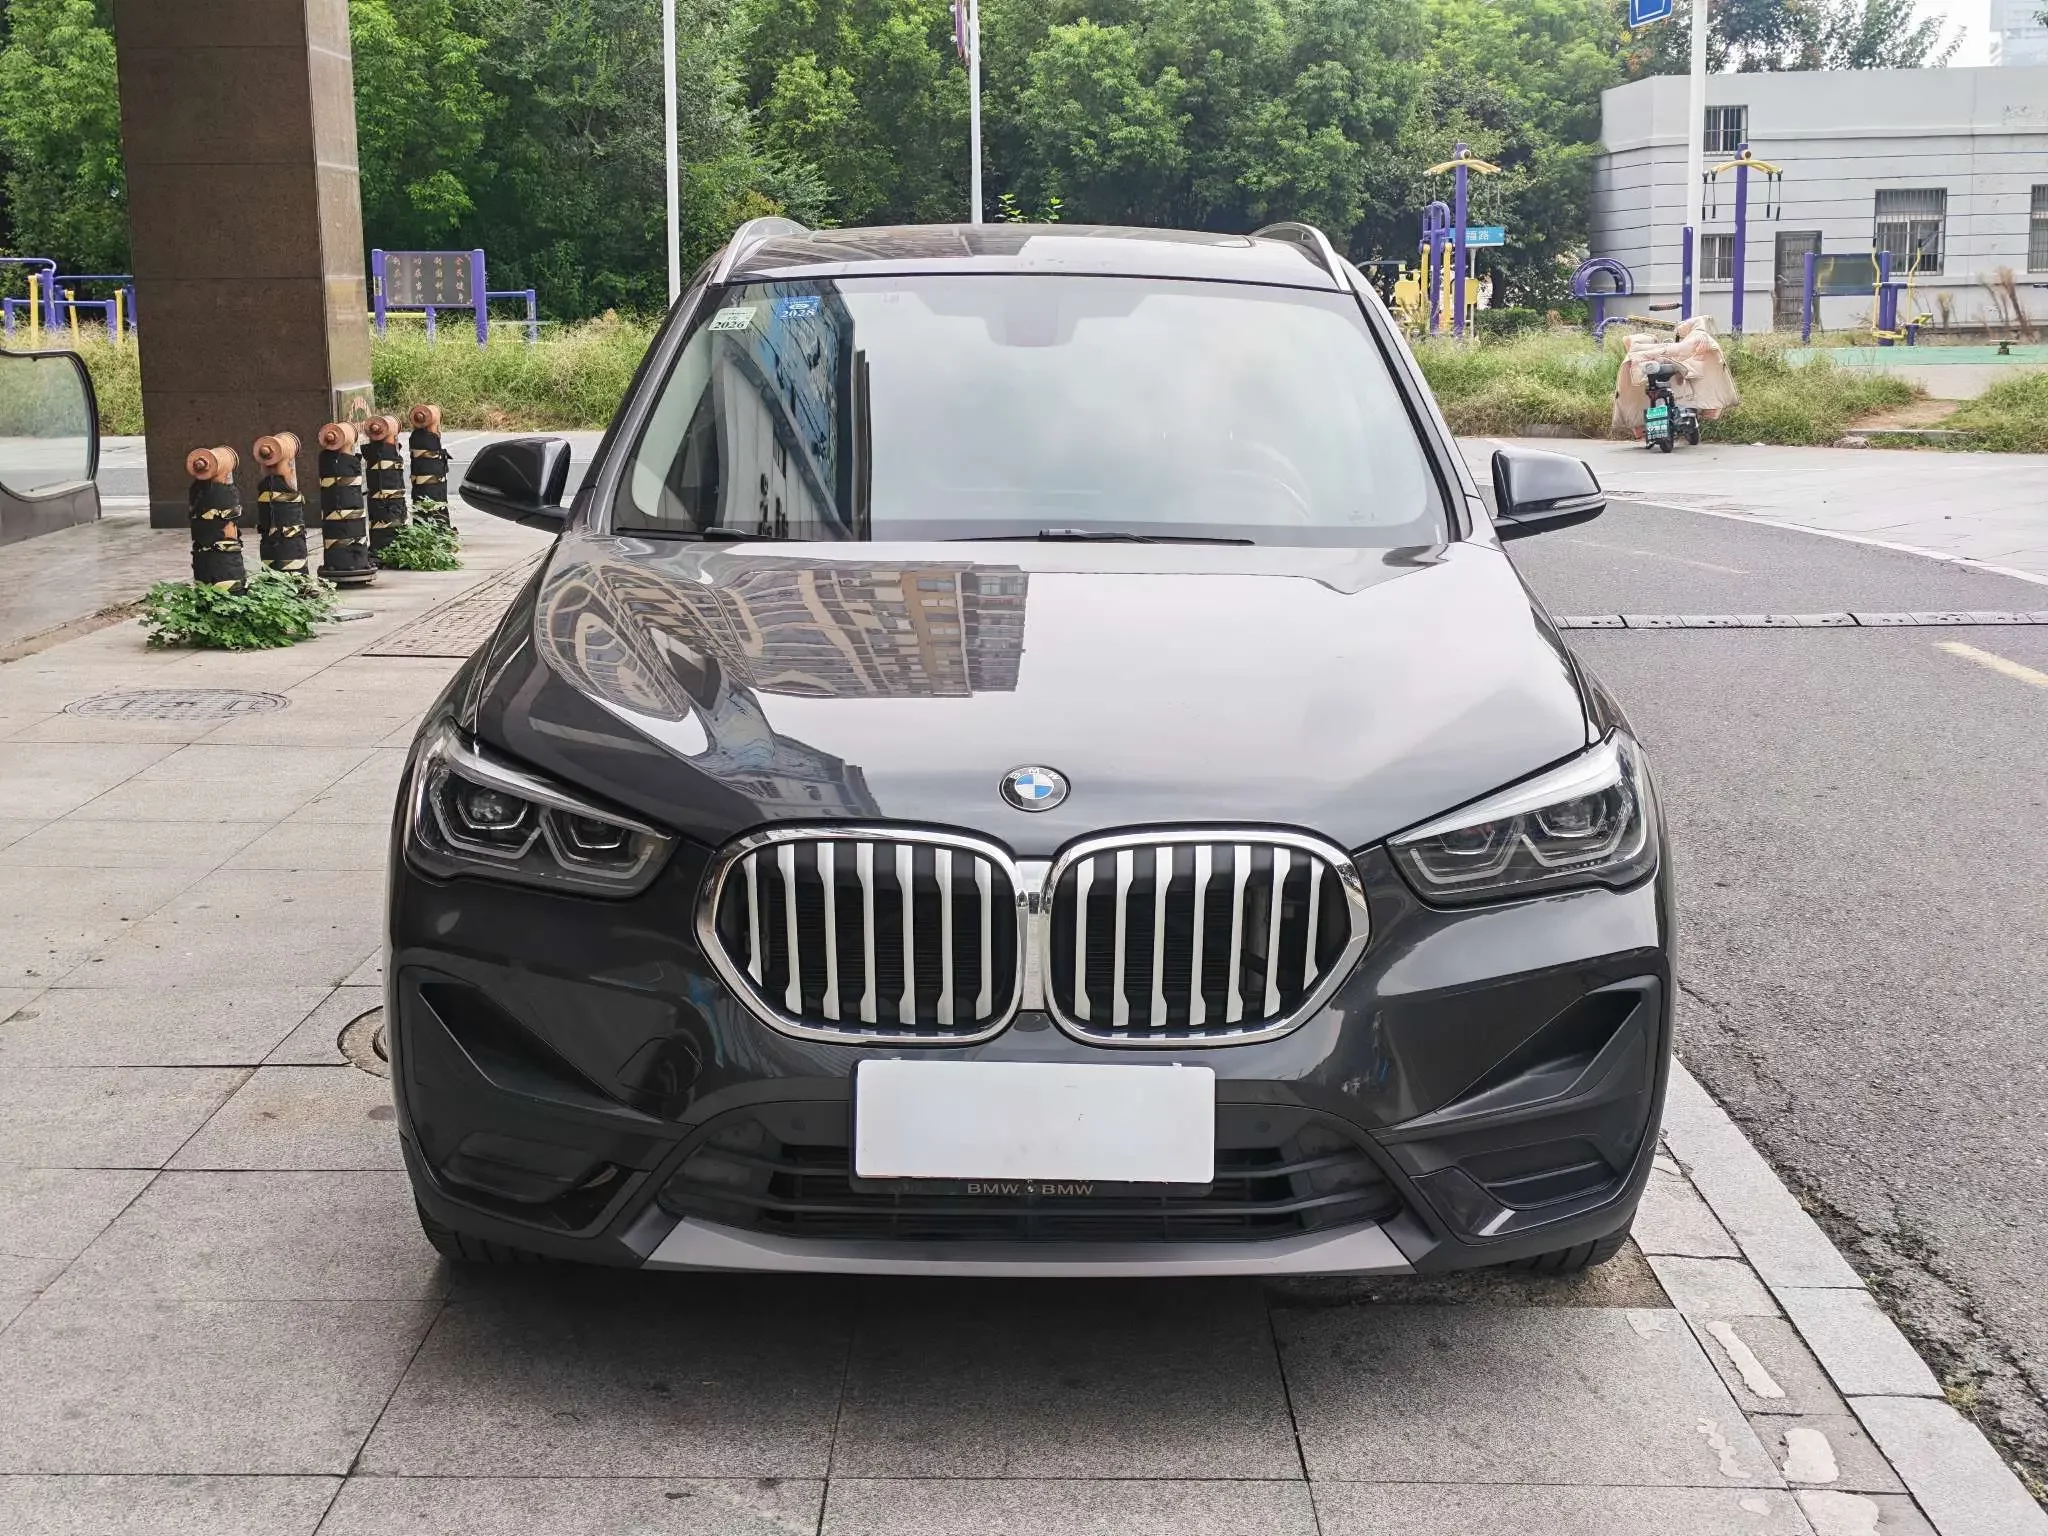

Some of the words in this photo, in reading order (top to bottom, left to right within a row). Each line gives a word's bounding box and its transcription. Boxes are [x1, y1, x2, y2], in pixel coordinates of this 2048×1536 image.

[779, 308, 816, 319] 2028
[713, 321, 745, 329] 2026
[967, 1183, 1020, 1194] BMW
[1042, 1184, 1094, 1195] BMW
